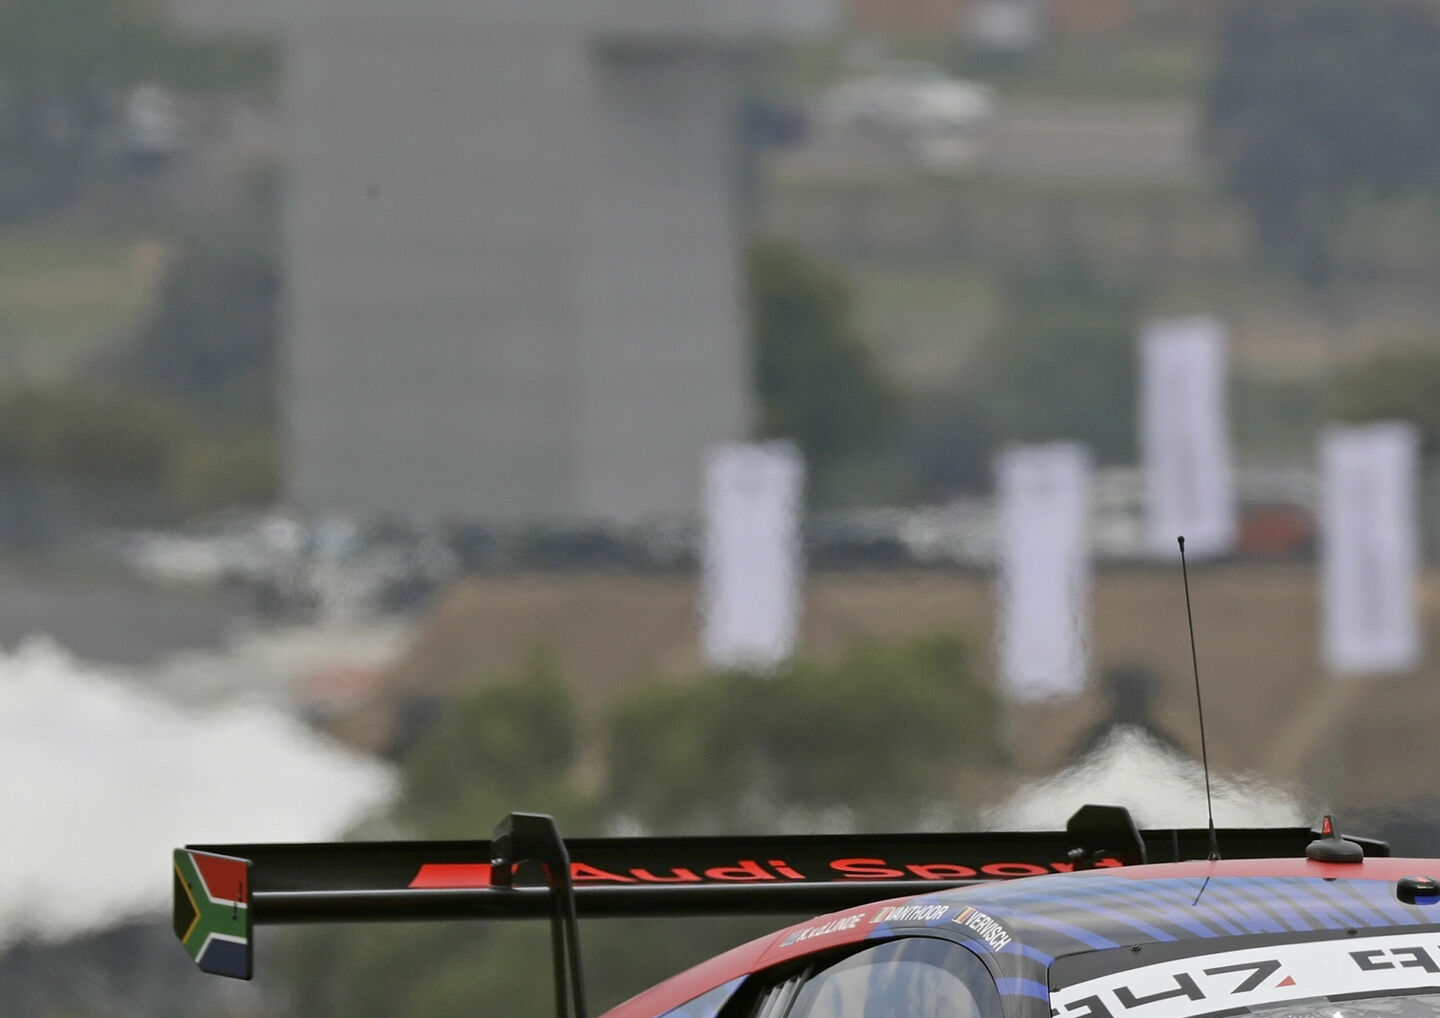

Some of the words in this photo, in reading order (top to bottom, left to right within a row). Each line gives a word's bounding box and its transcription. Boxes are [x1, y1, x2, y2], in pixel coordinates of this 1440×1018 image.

[569, 860, 806, 883] Audi
[885, 905, 949, 922] VANTHOOR
[963, 908, 1012, 952] VERVISCH
